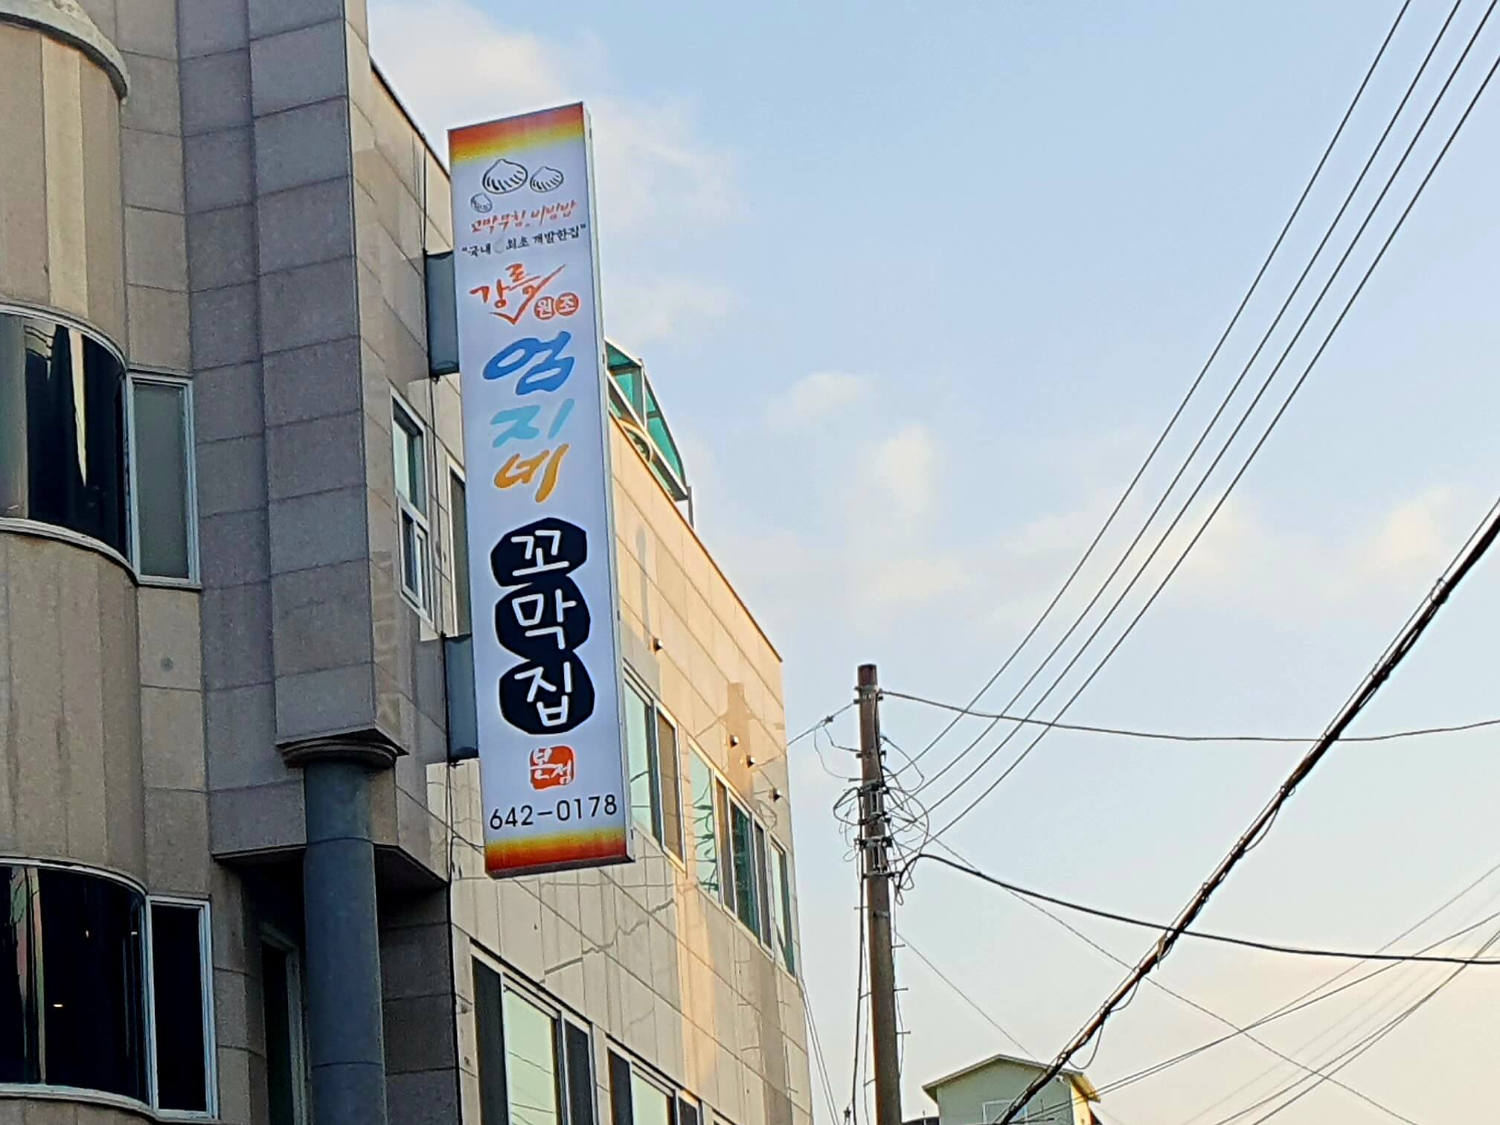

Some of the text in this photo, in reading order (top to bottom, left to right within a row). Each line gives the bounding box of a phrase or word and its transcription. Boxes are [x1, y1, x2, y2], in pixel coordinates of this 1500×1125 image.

[505, 236, 529, 251] 최초
[469, 262, 566, 326] 강릉
[534, 292, 580, 321] 원조
[481, 330, 576, 503] 엄지네
[510, 529, 577, 727] 꼬막집
[529, 746, 574, 790] 본점
[489, 794, 618, 830] 642-0178
